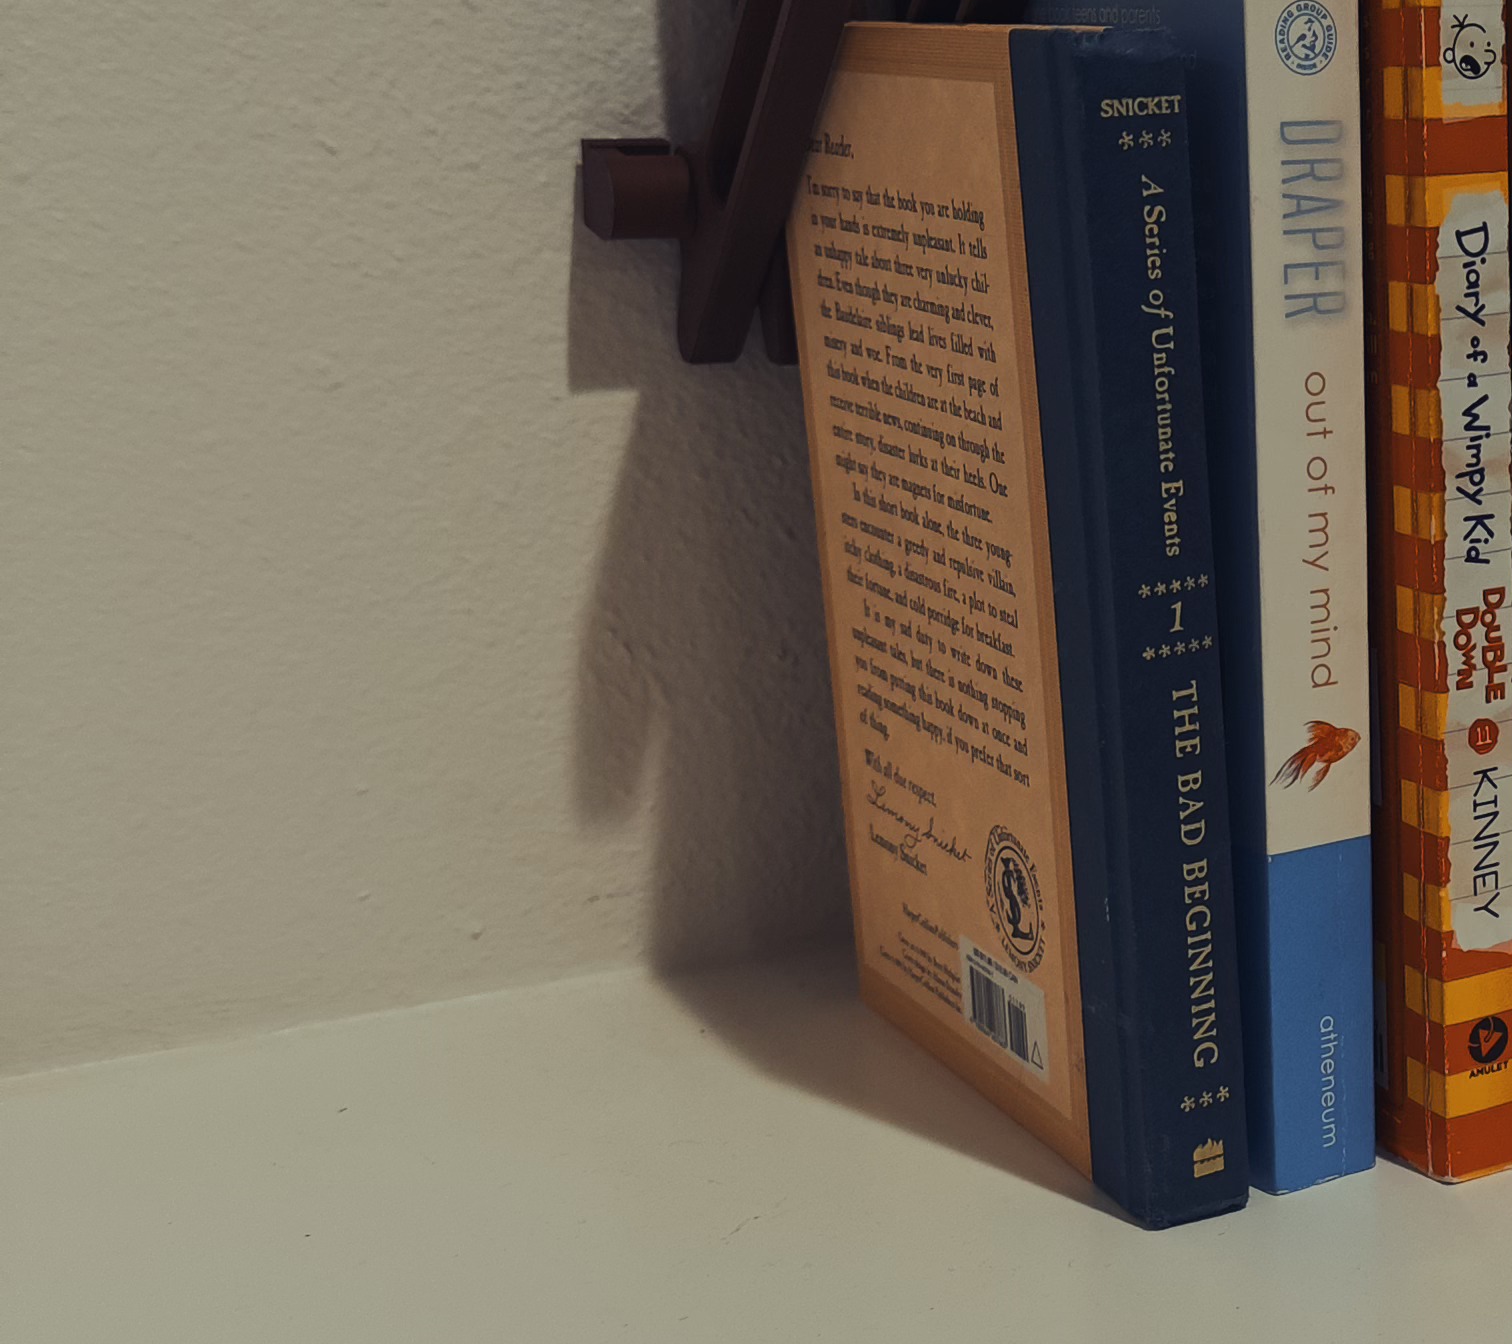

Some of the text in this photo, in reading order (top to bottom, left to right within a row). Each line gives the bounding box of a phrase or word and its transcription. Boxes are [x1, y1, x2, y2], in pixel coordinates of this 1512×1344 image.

[1099, 4, 1119, 23] and
[1121, 4, 1161, 25] parents
[1279, 10, 1294, 61] READING
[1296, 3, 1328, 20] GROUP
[1322, 24, 1334, 60] GUIDE
[1100, 96, 1181, 118] SNICKET
[937, 204, 949, 218] are
[951, 199, 985, 232] holding
[1280, 119, 1348, 320] DRAPER
[968, 235, 987, 258] tells
[936, 265, 969, 296] unlucky
[951, 301, 965, 321] and
[950, 331, 972, 356] filled
[978, 341, 995, 362] with
[946, 363, 964, 386] first
[968, 375, 985, 399] page
[1141, 174, 1184, 557] A Series of Unfortunate Events
[1455, 221, 1495, 564] Diary of a Wimpy Kid
[948, 395, 961, 418] the
[963, 400, 985, 425] beach
[988, 410, 1002, 430] and
[957, 430, 989, 464] through
[989, 472, 1007, 497] One
[962, 524, 982, 551] three
[1302, 372, 1338, 689] out of my mind
[949, 556, 984, 583] repulsive
[968, 590, 984, 616] plot
[999, 603, 1017, 628] steal
[1169, 601, 1184, 633] 1
[1454, 607, 1480, 690] DOWN
[1481, 587, 1508, 703] DOUBLE
[975, 651, 997, 680] down
[1002, 664, 1023, 692] these
[957, 677, 988, 712] nothing
[991, 691, 1026, 732] stopping
[992, 725, 1010, 747] once
[1013, 735, 1027, 756] and
[1476, 725, 1492, 745] 11
[971, 744, 994, 768] prefer
[996, 751, 1011, 777] that
[1013, 767, 1029, 787] sort
[1473, 767, 1499, 918] KINNEY
[1172, 680, 1219, 1068] THE BAD BEGINNING
[1319, 1015, 1338, 1148] atheneum
[1469, 1059, 1509, 1078] AMULET
